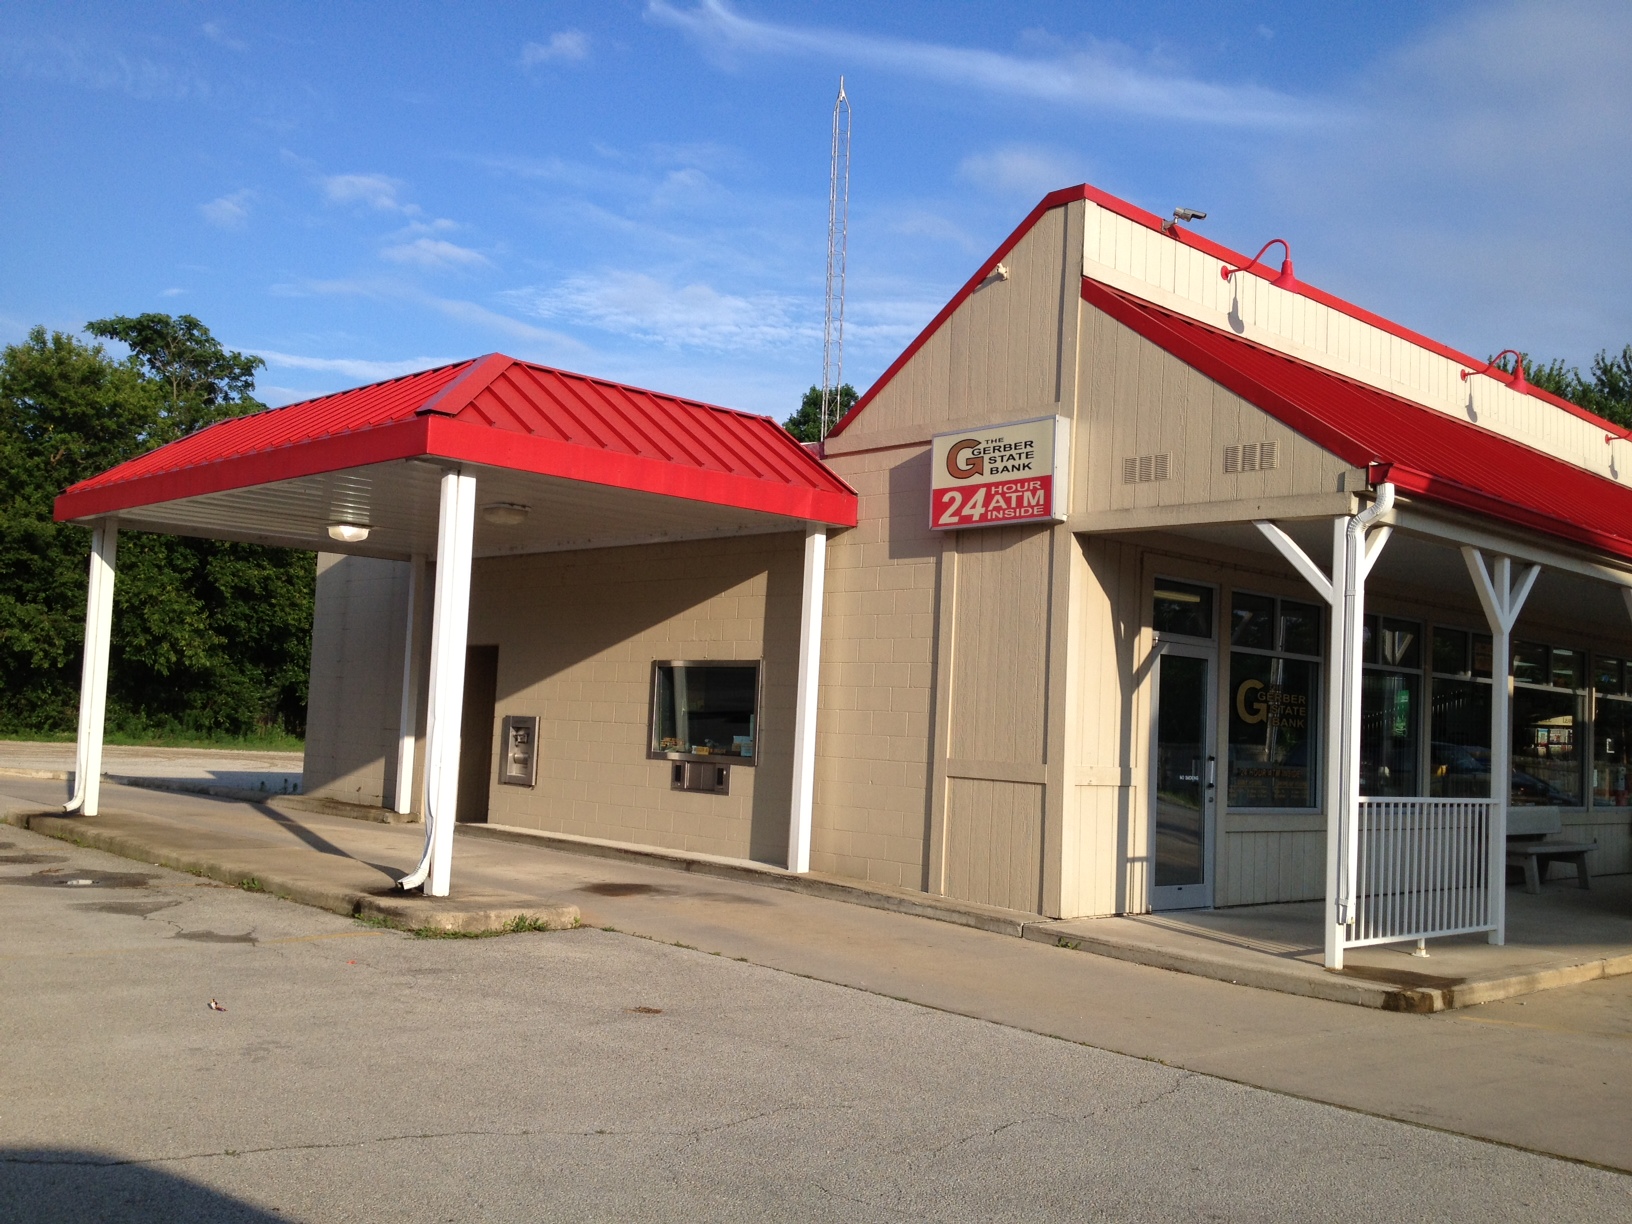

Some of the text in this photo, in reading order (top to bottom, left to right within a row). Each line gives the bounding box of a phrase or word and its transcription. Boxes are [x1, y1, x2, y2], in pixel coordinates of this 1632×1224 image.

[984, 437, 1004, 445] THE
[971, 440, 1034, 456] GERBER
[946, 438, 984, 479] G
[988, 451, 1035, 464] STATE
[990, 462, 1032, 475] BANK
[991, 481, 1042, 494] HOUR
[938, 487, 987, 525] 24
[988, 490, 1044, 510] ATM
[987, 506, 1044, 519] INSIDE
[1236, 679, 1267, 724] G
[1257, 691, 1306, 704] GERBER
[1271, 705, 1306, 716] STATE
[1272, 718, 1304, 728] BANK
